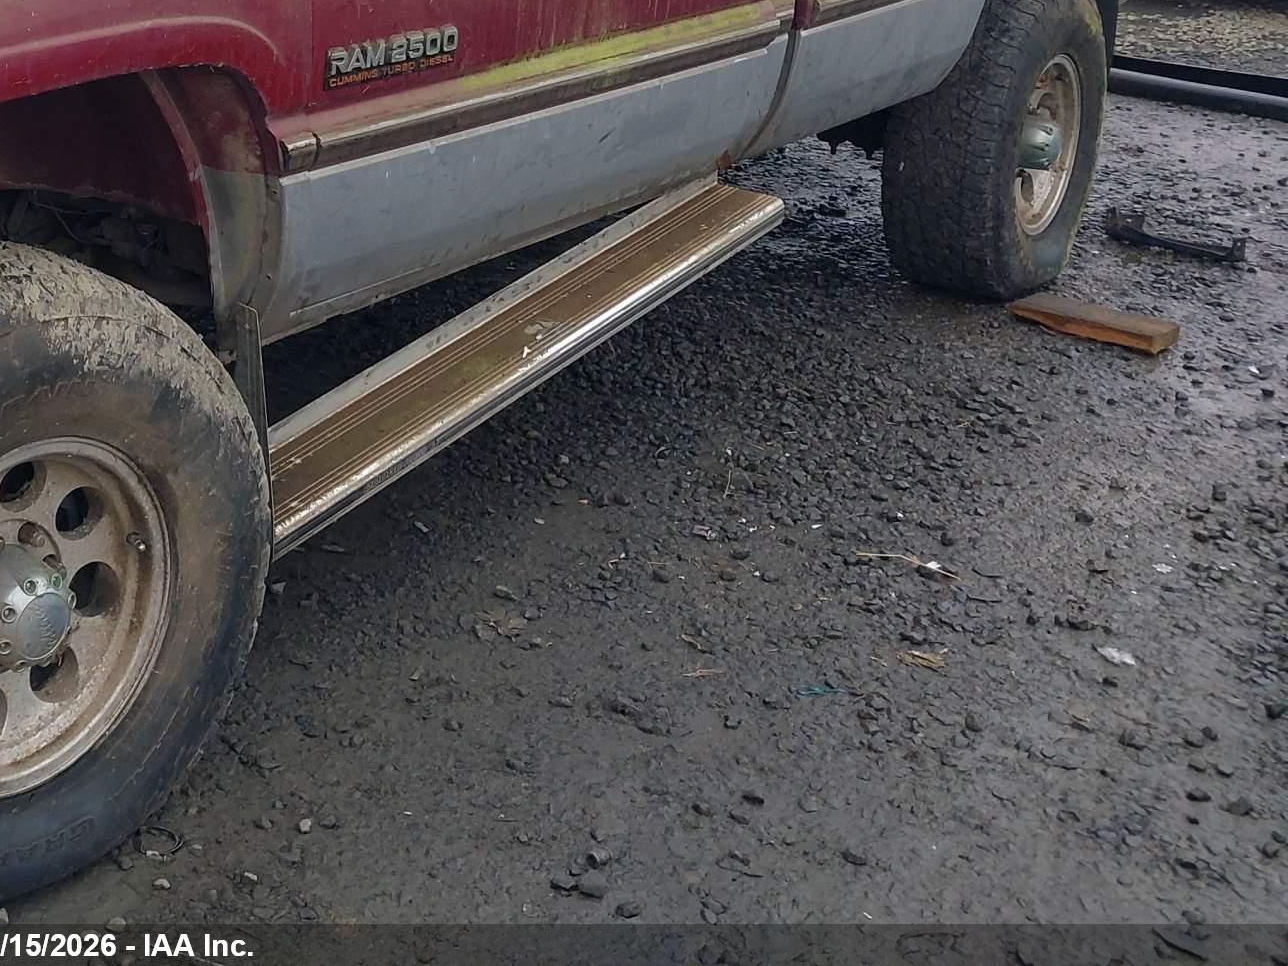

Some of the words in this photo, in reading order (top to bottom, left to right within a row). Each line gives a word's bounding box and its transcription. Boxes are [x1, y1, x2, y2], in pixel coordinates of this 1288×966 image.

[328, 39, 386, 75] RAM
[390, 24, 459, 62] 2500
[329, 69, 378, 87] CUMMINS
[382, 62, 416, 77] TURBO
[419, 55, 454, 68] DIESEL
